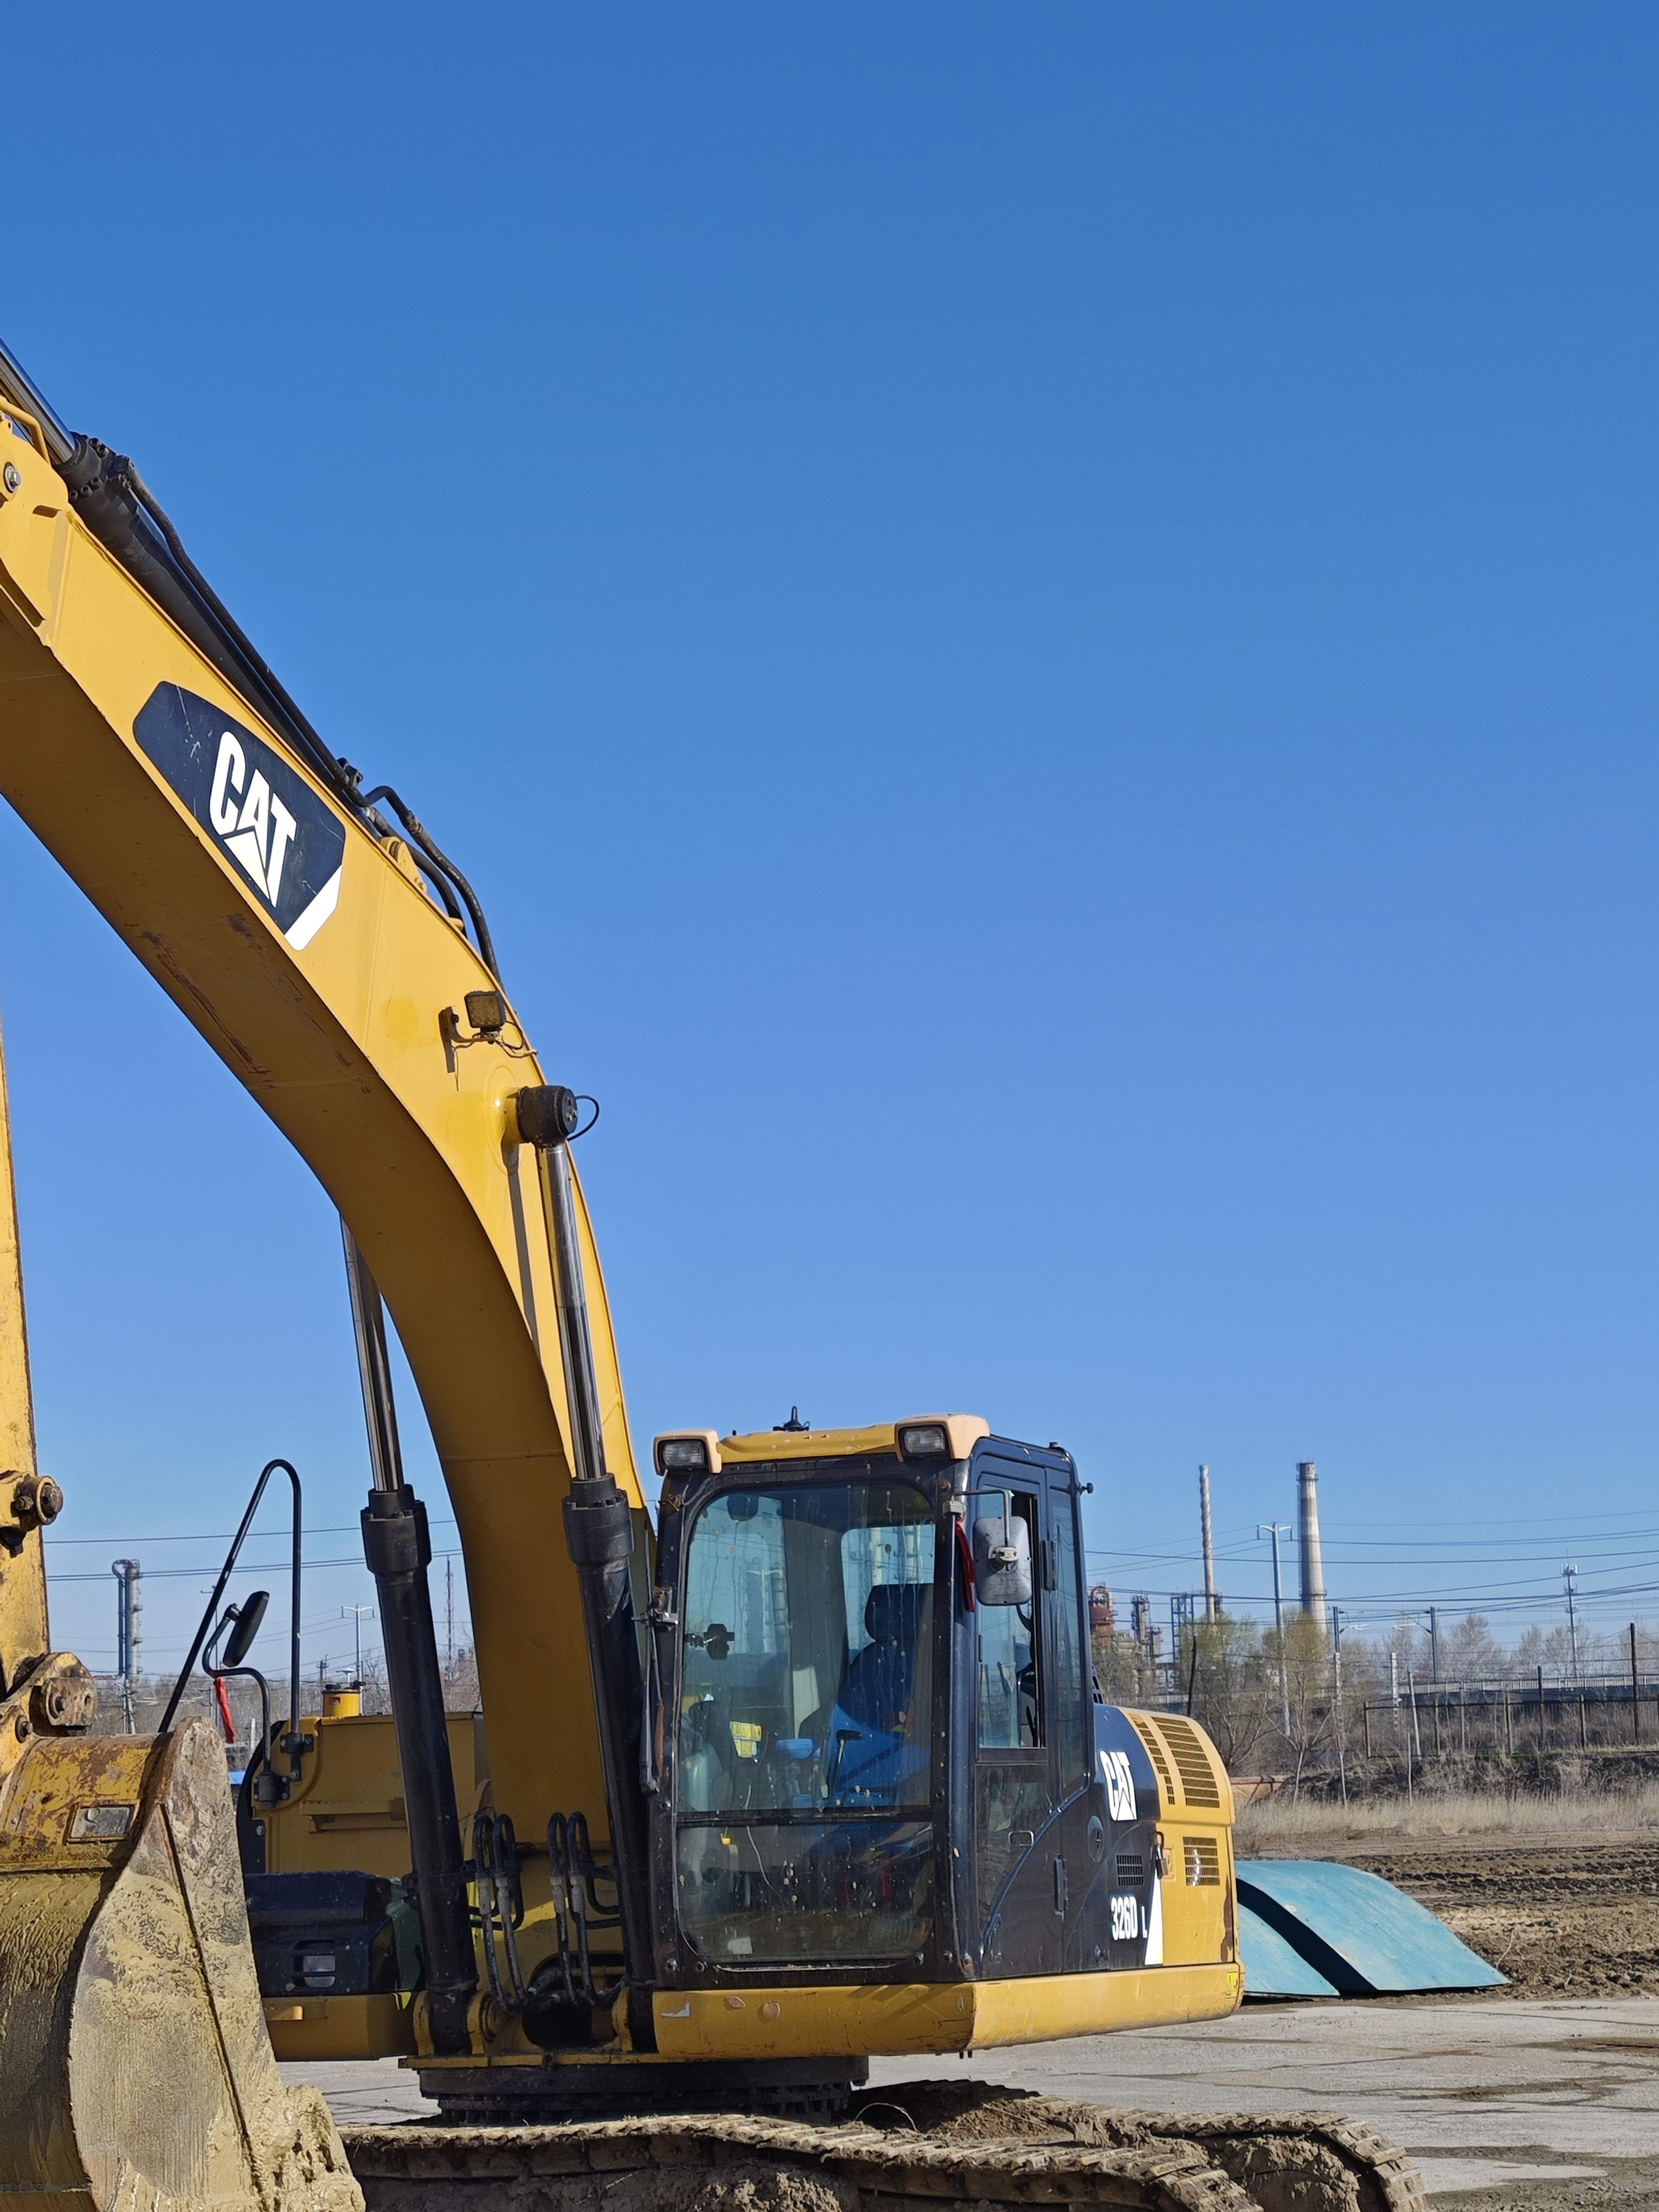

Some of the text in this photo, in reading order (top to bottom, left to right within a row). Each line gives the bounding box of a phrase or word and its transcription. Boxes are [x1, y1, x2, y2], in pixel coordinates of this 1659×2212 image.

[210, 731, 298, 908] CAT
[1099, 1750, 1137, 1821] CAT
[1111, 1896, 1148, 1940] 326D L
